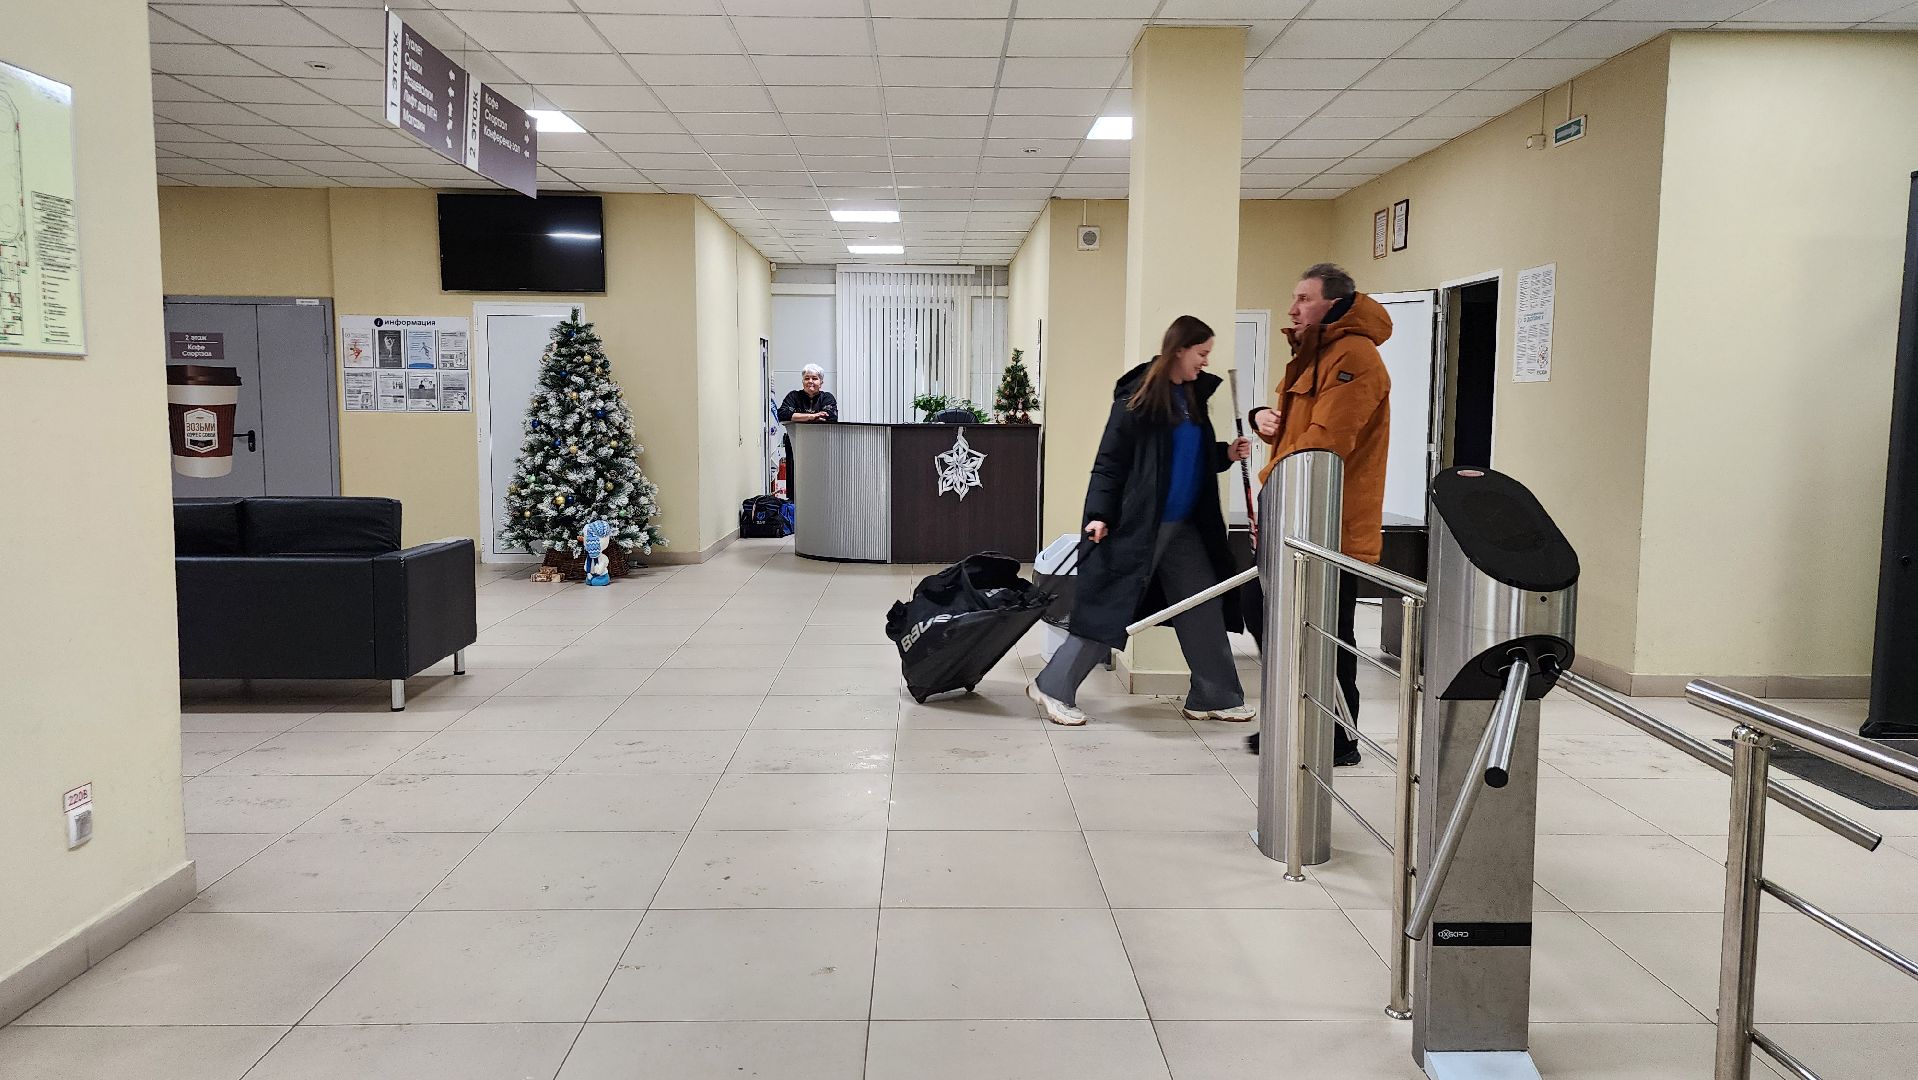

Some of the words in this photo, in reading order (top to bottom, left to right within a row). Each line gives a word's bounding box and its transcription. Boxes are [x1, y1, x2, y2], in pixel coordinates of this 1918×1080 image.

[405, 32, 423, 57] Туалет
[484, 108, 508, 131] Спортзал
[470, 146, 476, 158] 2
[384, 318, 436, 327] информация
[181, 350, 213, 358] Спортзал
[186, 422, 216, 432] ВОЗЬМИ
[900, 612, 970, 653] BAUE
